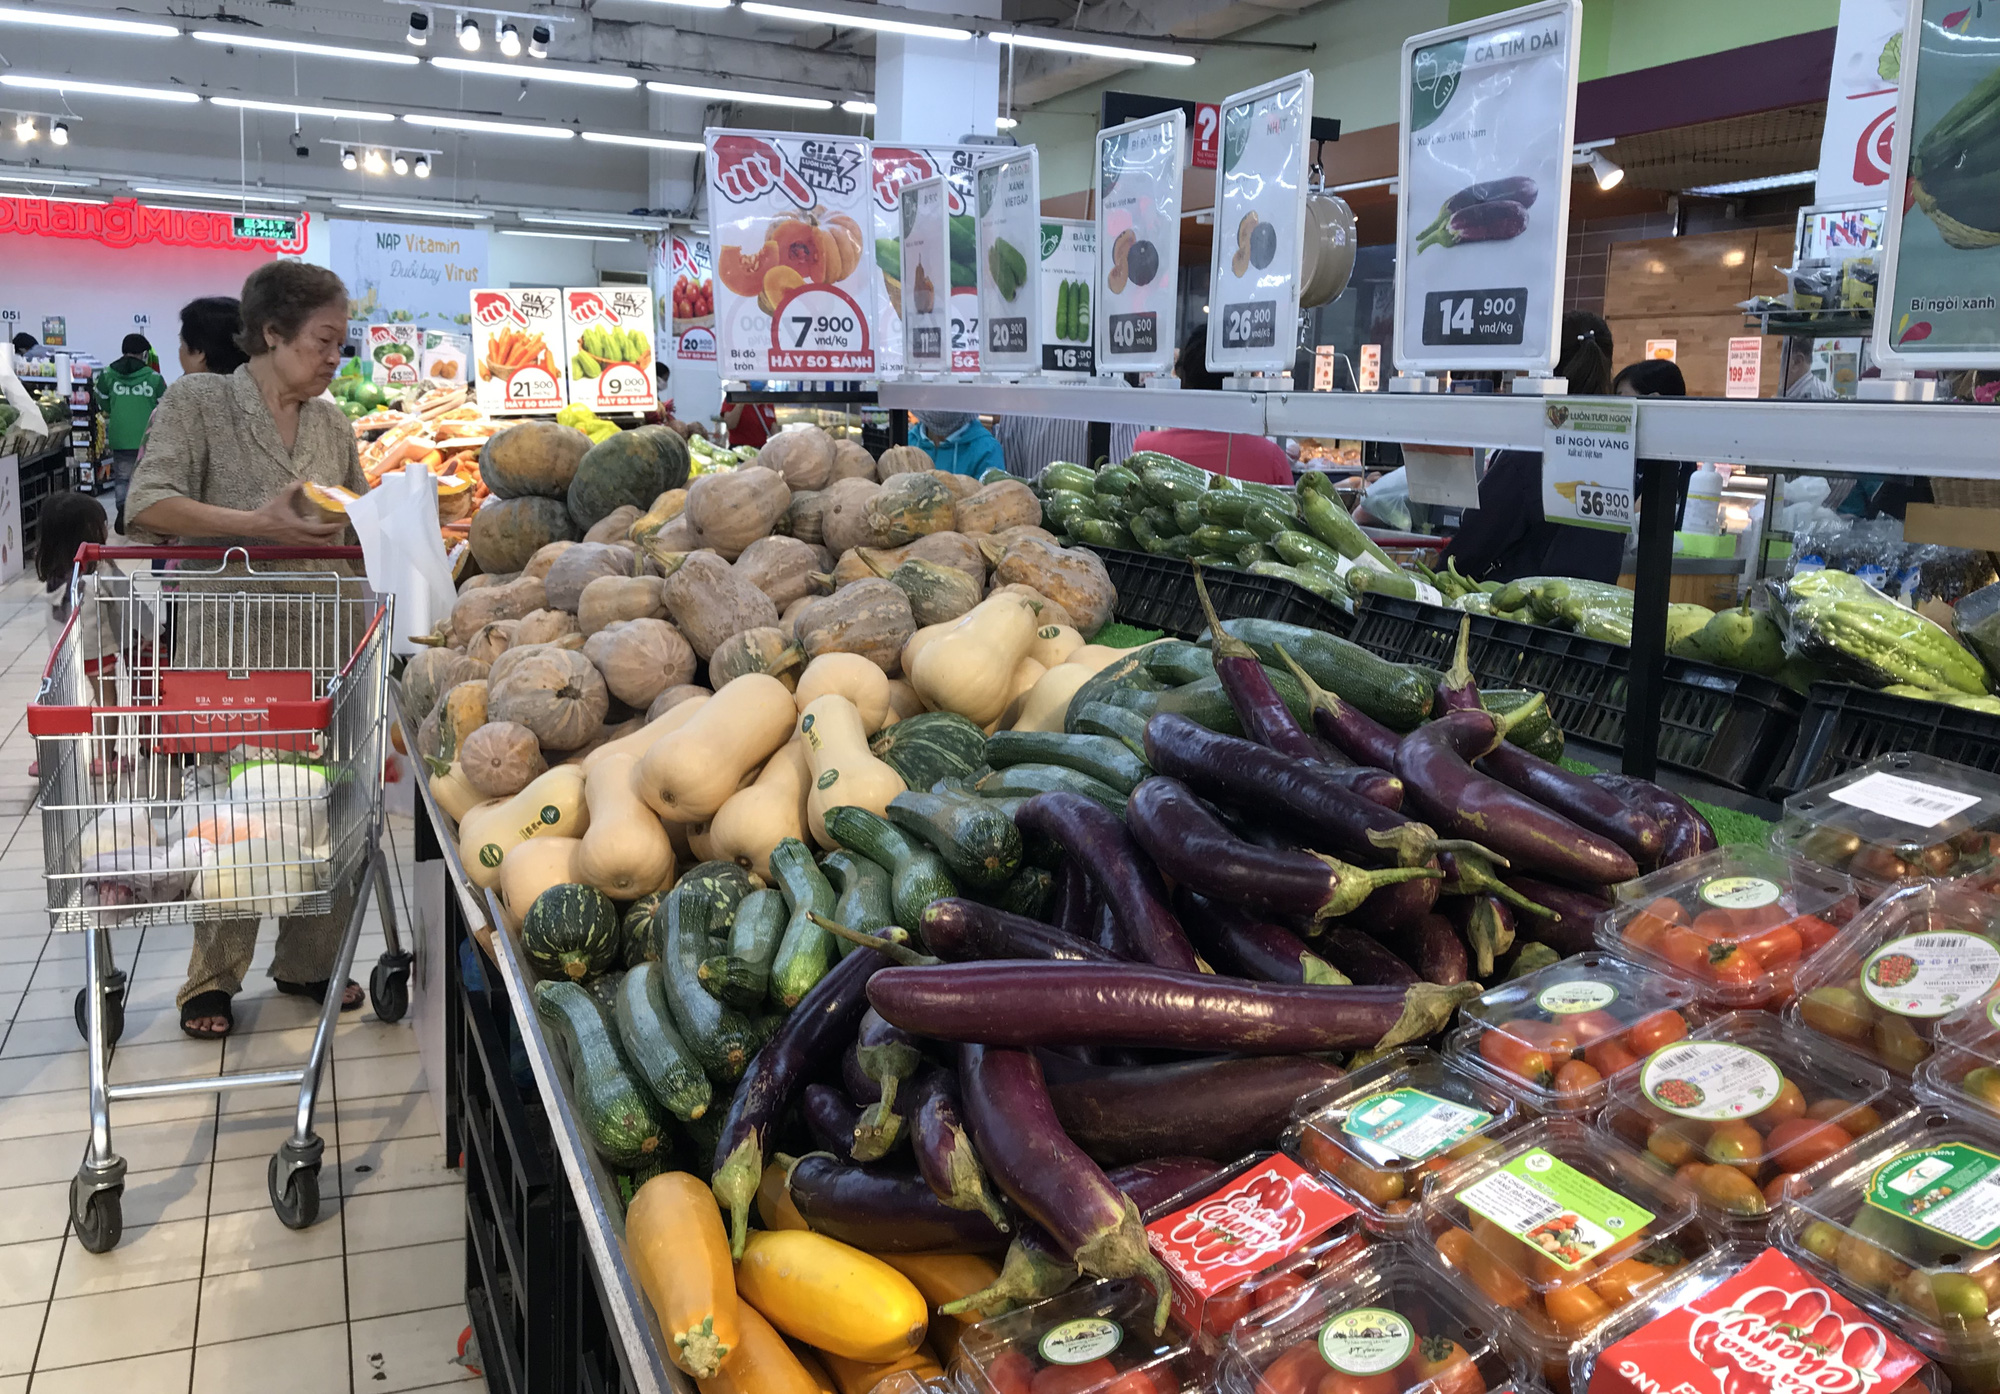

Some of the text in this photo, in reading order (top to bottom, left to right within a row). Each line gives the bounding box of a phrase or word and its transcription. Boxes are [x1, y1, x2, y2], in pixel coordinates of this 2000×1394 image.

[1500, 38, 1525, 57] TIM
[244, 218, 286, 230] EXIT
[405, 234, 460, 254] Vitamin
[420, 262, 441, 285] bay
[445, 263, 479, 282] Virus
[1911, 295, 1996, 313] Bí ngòi xanh
[2, 311, 16, 320] 05
[134, 315, 147, 324] 04
[1480, 321, 1513, 335] vnd/Kg
[815, 335, 848, 347] vnd/Kg
[771, 354, 872, 368] HÃY SO SÁNH
[113, 381, 154, 397] Grab
[1555, 435, 1630, 450] BÍ NGÒI VÀNG
[1203, 1206, 1280, 1247] Cherry
[1723, 1317, 1853, 1390] Cherry
